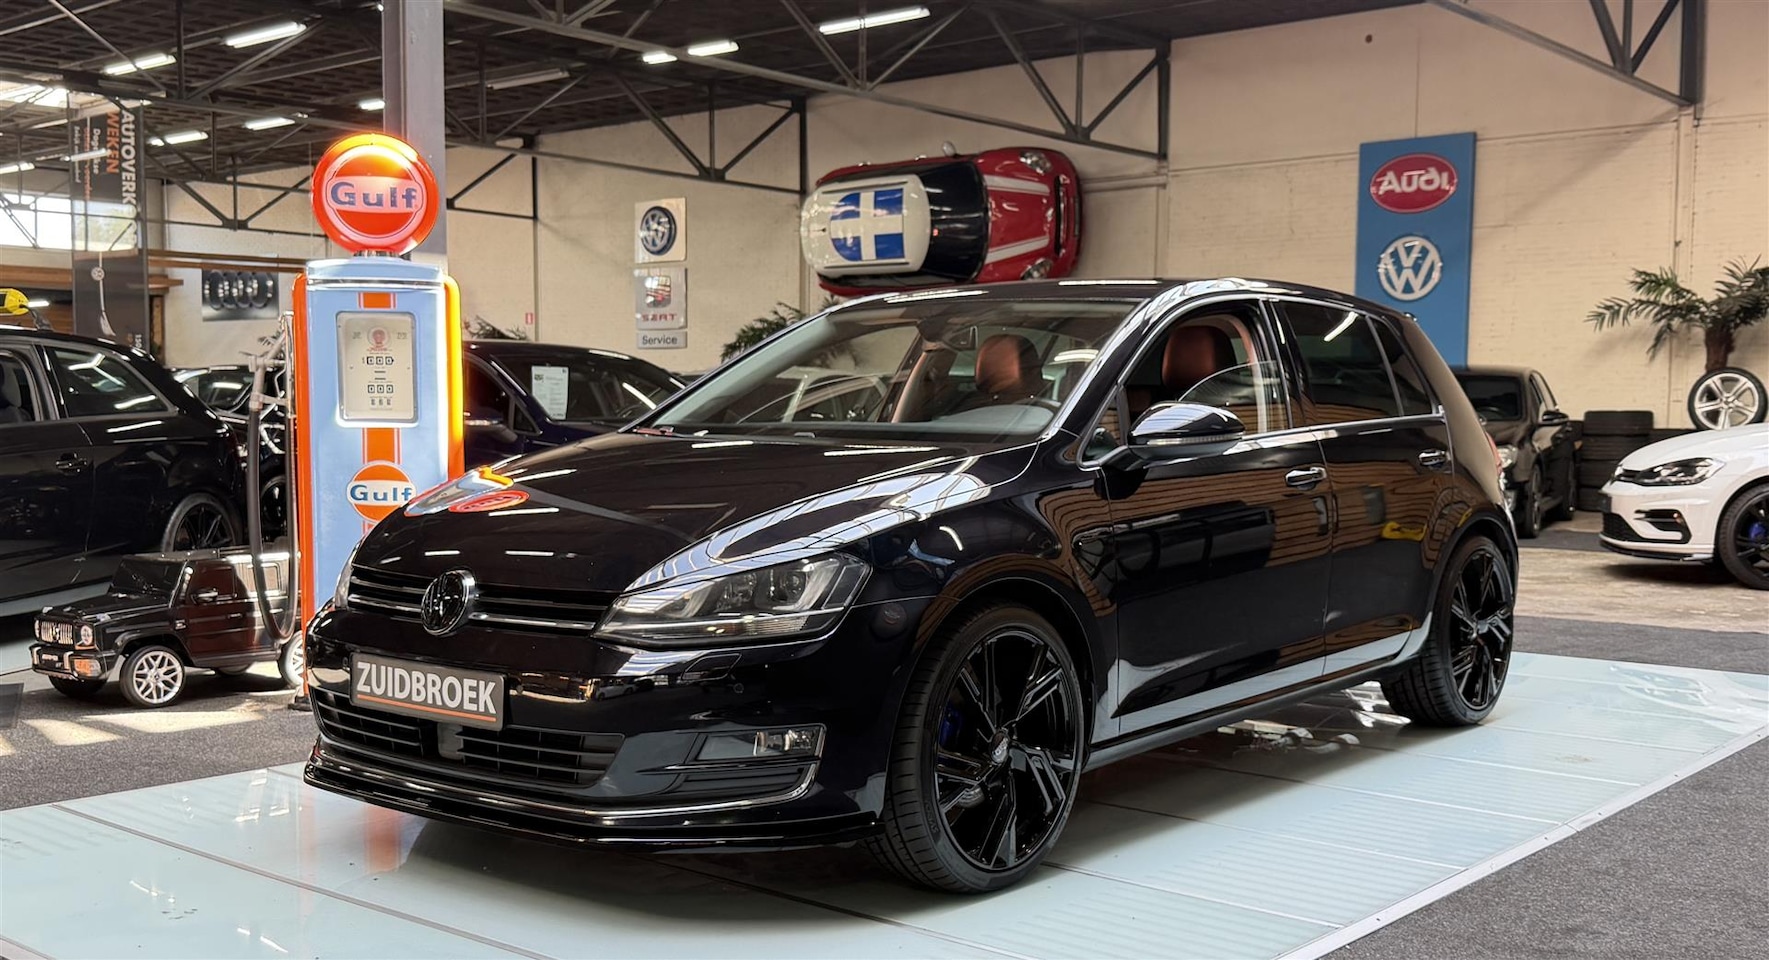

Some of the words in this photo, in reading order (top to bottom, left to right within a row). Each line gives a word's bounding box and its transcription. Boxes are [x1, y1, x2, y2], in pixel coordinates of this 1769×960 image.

[106, 112, 120, 174] WEKEN
[330, 181, 417, 208] Gulf
[642, 334, 678, 345] Service
[350, 484, 412, 501] Gulf
[356, 661, 497, 714] ZUIDBROEK
